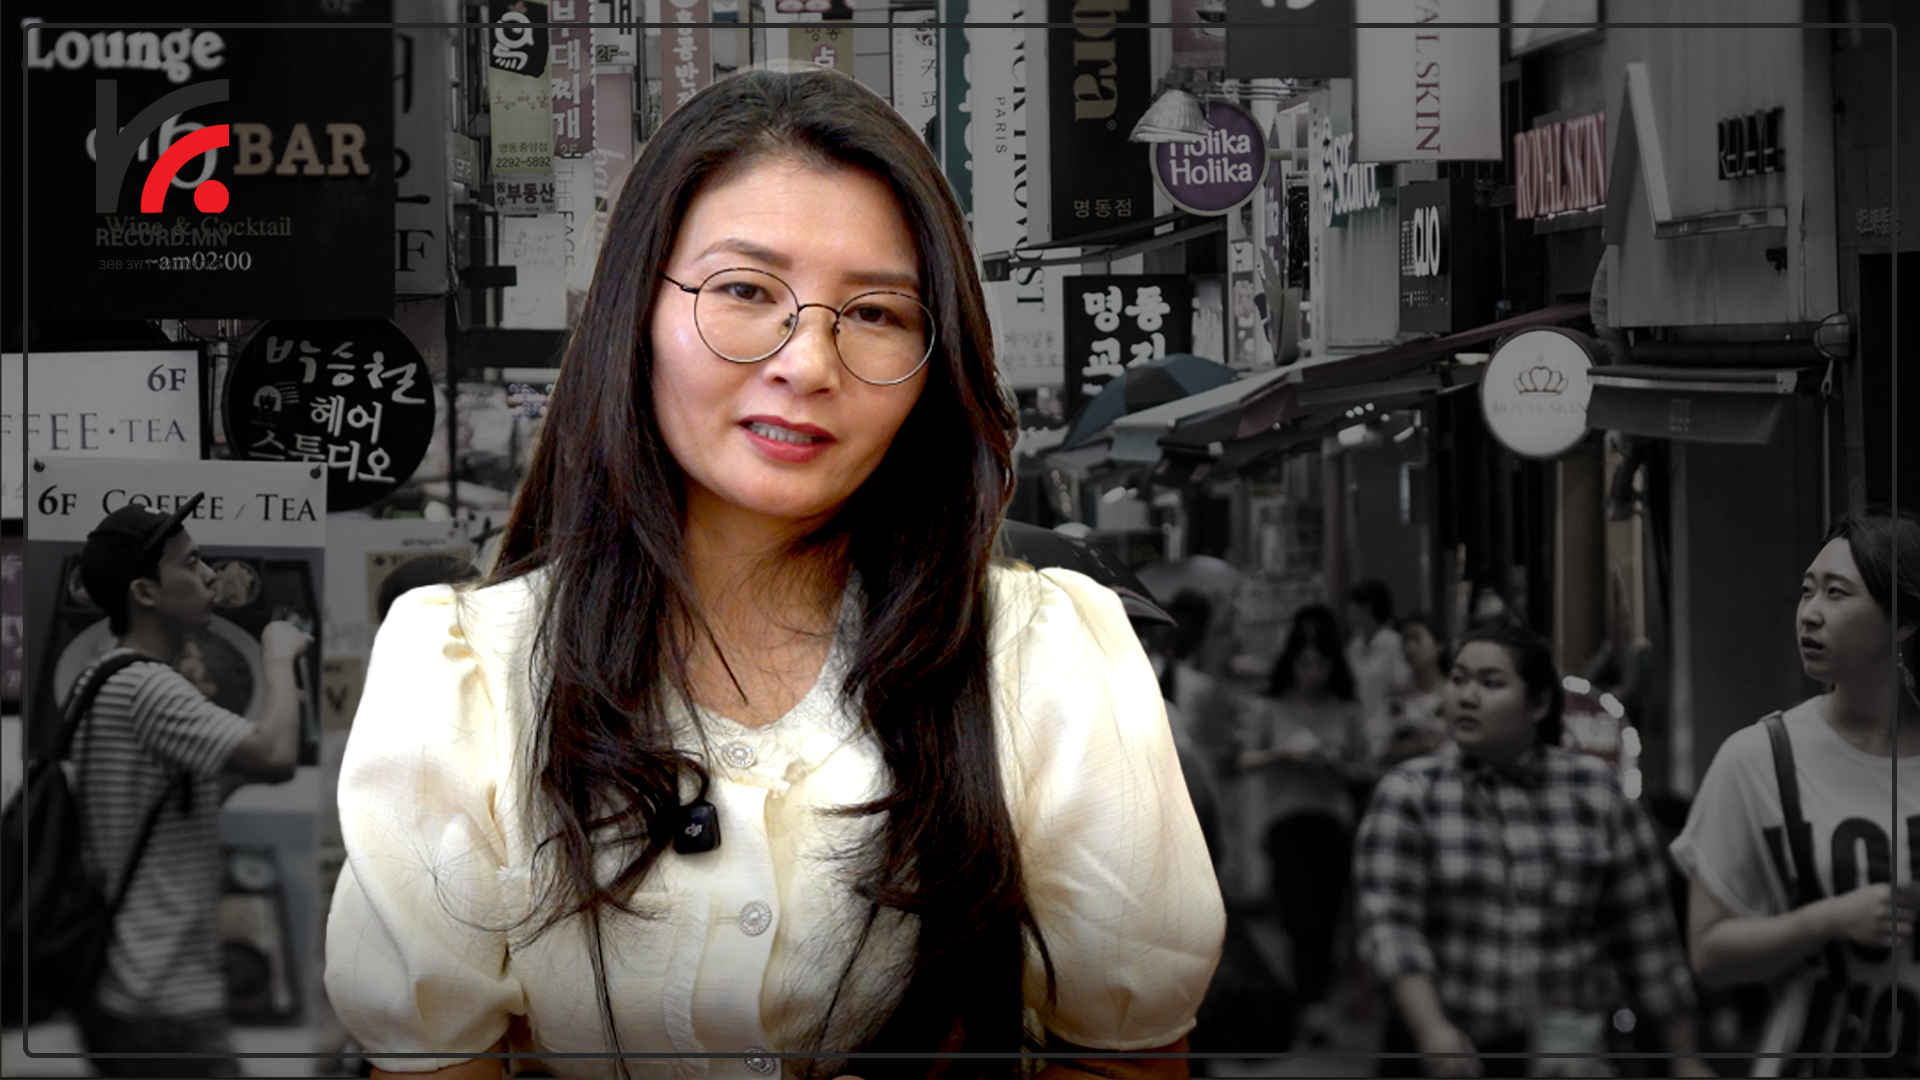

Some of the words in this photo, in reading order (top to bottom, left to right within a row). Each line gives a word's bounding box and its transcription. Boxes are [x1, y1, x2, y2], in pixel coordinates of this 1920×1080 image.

[21, 17, 226, 83] Lounge
[995, 96, 1013, 154] PARIS
[1416, 61, 1441, 153] SKIN
[232, 122, 371, 176] BAR
[496, 156, 551, 168] 2292-5892
[1514, 124, 1565, 219] ROYAL
[1564, 111, 1605, 210] SKIN
[507, 181, 555, 204] 부동산
[1169, 157, 1253, 186] Holika
[104, 214, 164, 237] Wine
[200, 214, 292, 238] Cocktail
[1073, 198, 1132, 218] 명동점
[1082, 285, 1171, 332] 명동
[147, 363, 187, 392] 6F
[265, 334, 427, 404] 박승철
[119, 418, 187, 443] TEA
[309, 394, 384, 445] 헤어
[37, 485, 77, 516] 6F
[256, 493, 318, 522] TEA
